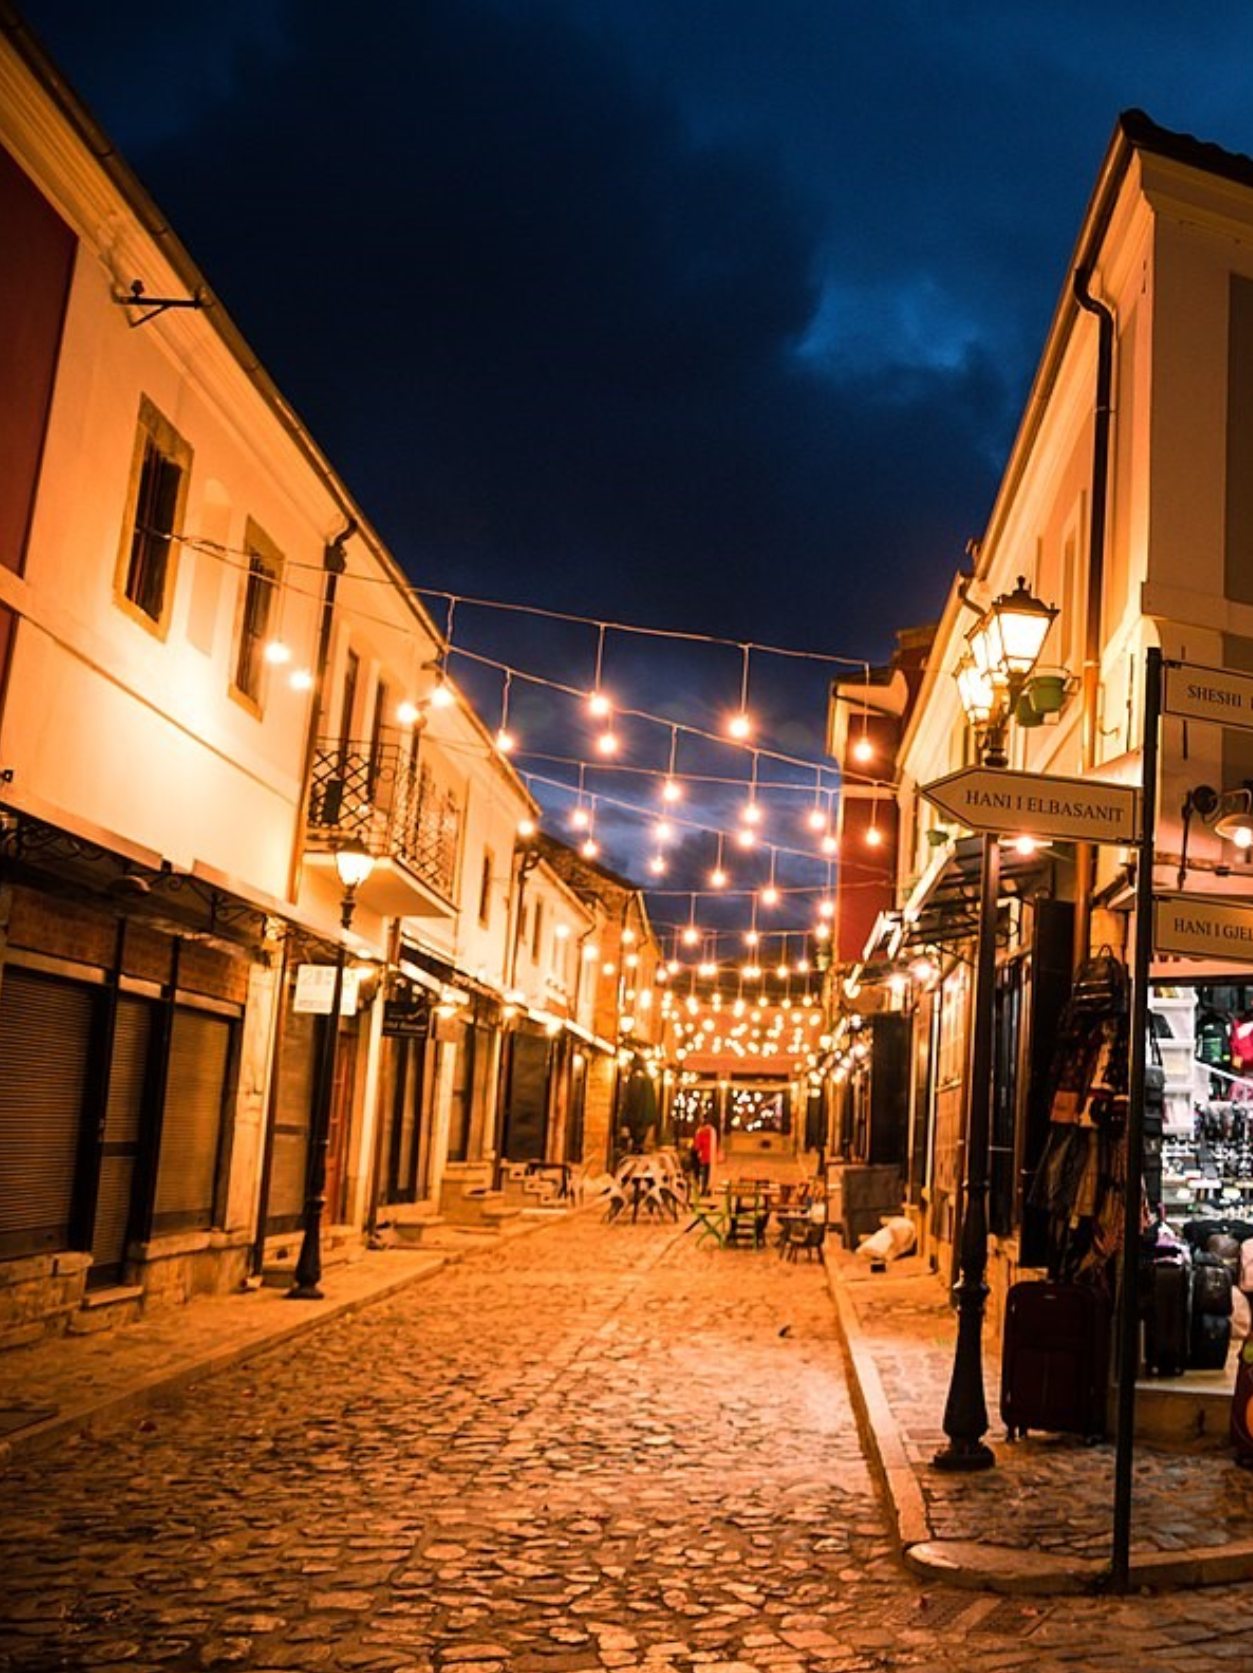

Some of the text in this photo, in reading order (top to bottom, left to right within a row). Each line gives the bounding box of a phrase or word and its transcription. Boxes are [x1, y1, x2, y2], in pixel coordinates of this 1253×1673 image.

[1187, 684, 1242, 707] SHESHI
[966, 790, 1125, 823] HANI I ELBASANIT
[1174, 917, 1211, 936] HANI
